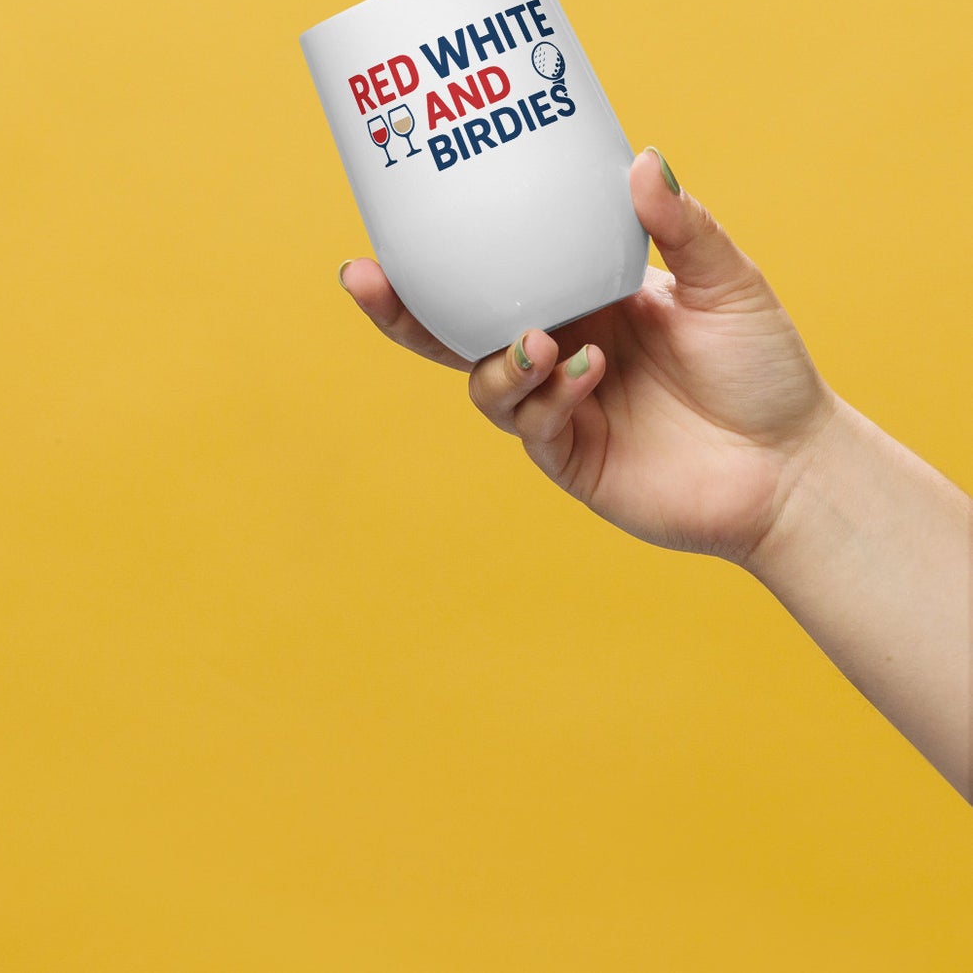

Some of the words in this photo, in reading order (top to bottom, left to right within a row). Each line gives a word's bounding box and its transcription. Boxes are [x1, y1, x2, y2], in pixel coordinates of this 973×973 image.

[348, 54, 420, 115] RED
[419, 0, 555, 79] WHITE
[426, 65, 511, 130] AND
[427, 84, 576, 172] BIRDIES
